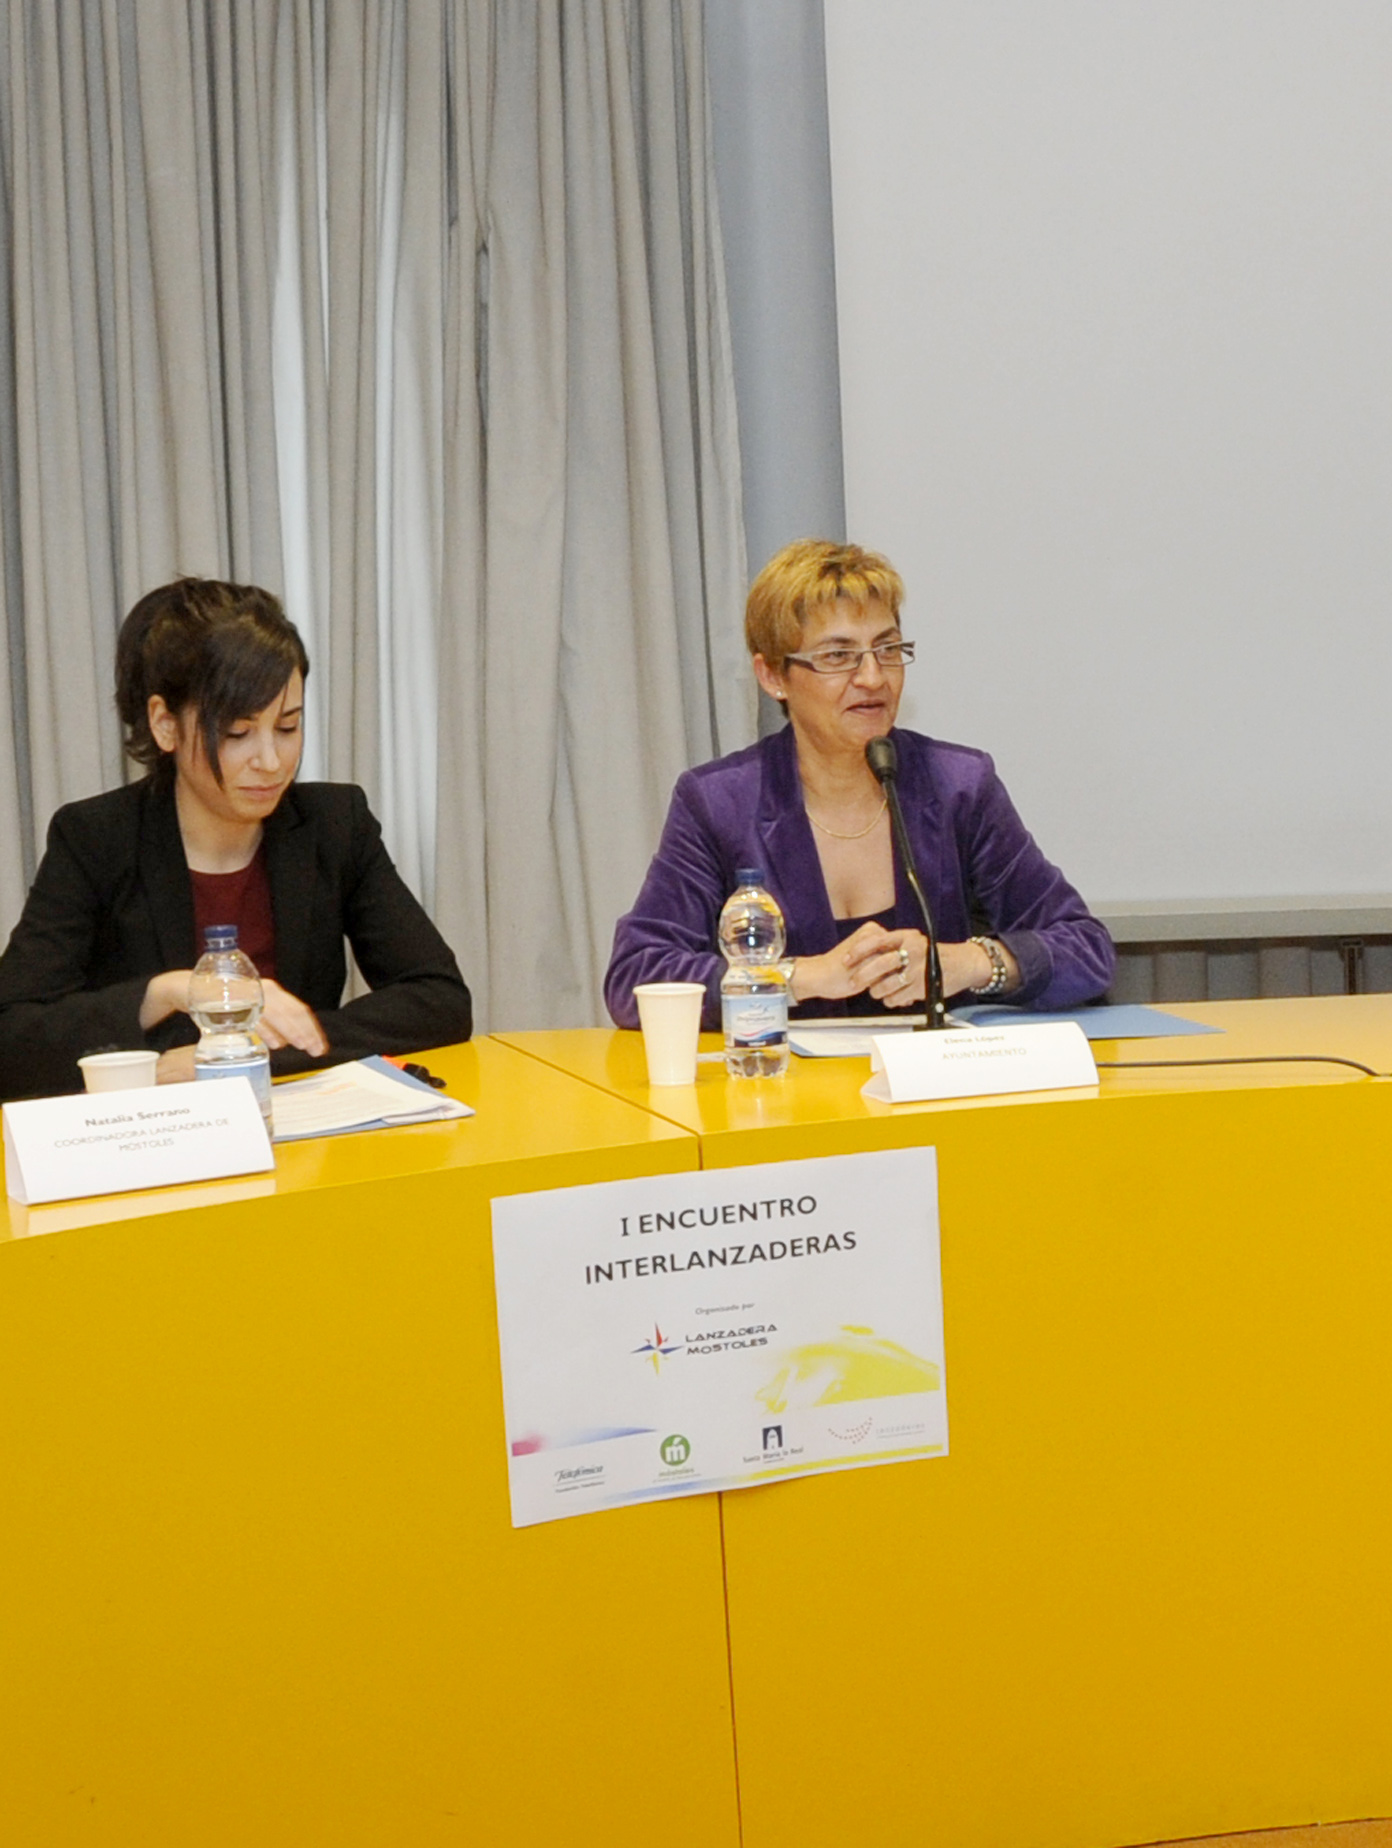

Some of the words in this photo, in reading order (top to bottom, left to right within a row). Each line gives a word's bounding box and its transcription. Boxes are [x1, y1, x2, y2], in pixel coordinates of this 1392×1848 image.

[84, 1113, 134, 1127] Natalia
[136, 1106, 191, 1121] Serrano
[53, 1129, 148, 1149] COORDINADORA
[148, 1120, 213, 1136] LANZADERA
[215, 1117, 230, 1127] DE
[619, 1216, 630, 1237] I
[638, 1195, 818, 1235] ENCUENTRO
[585, 1230, 858, 1285] INTERLANZADERAS
[685, 1323, 778, 1343] LANZADERA
[686, 1337, 768, 1355] MOSTOLES
